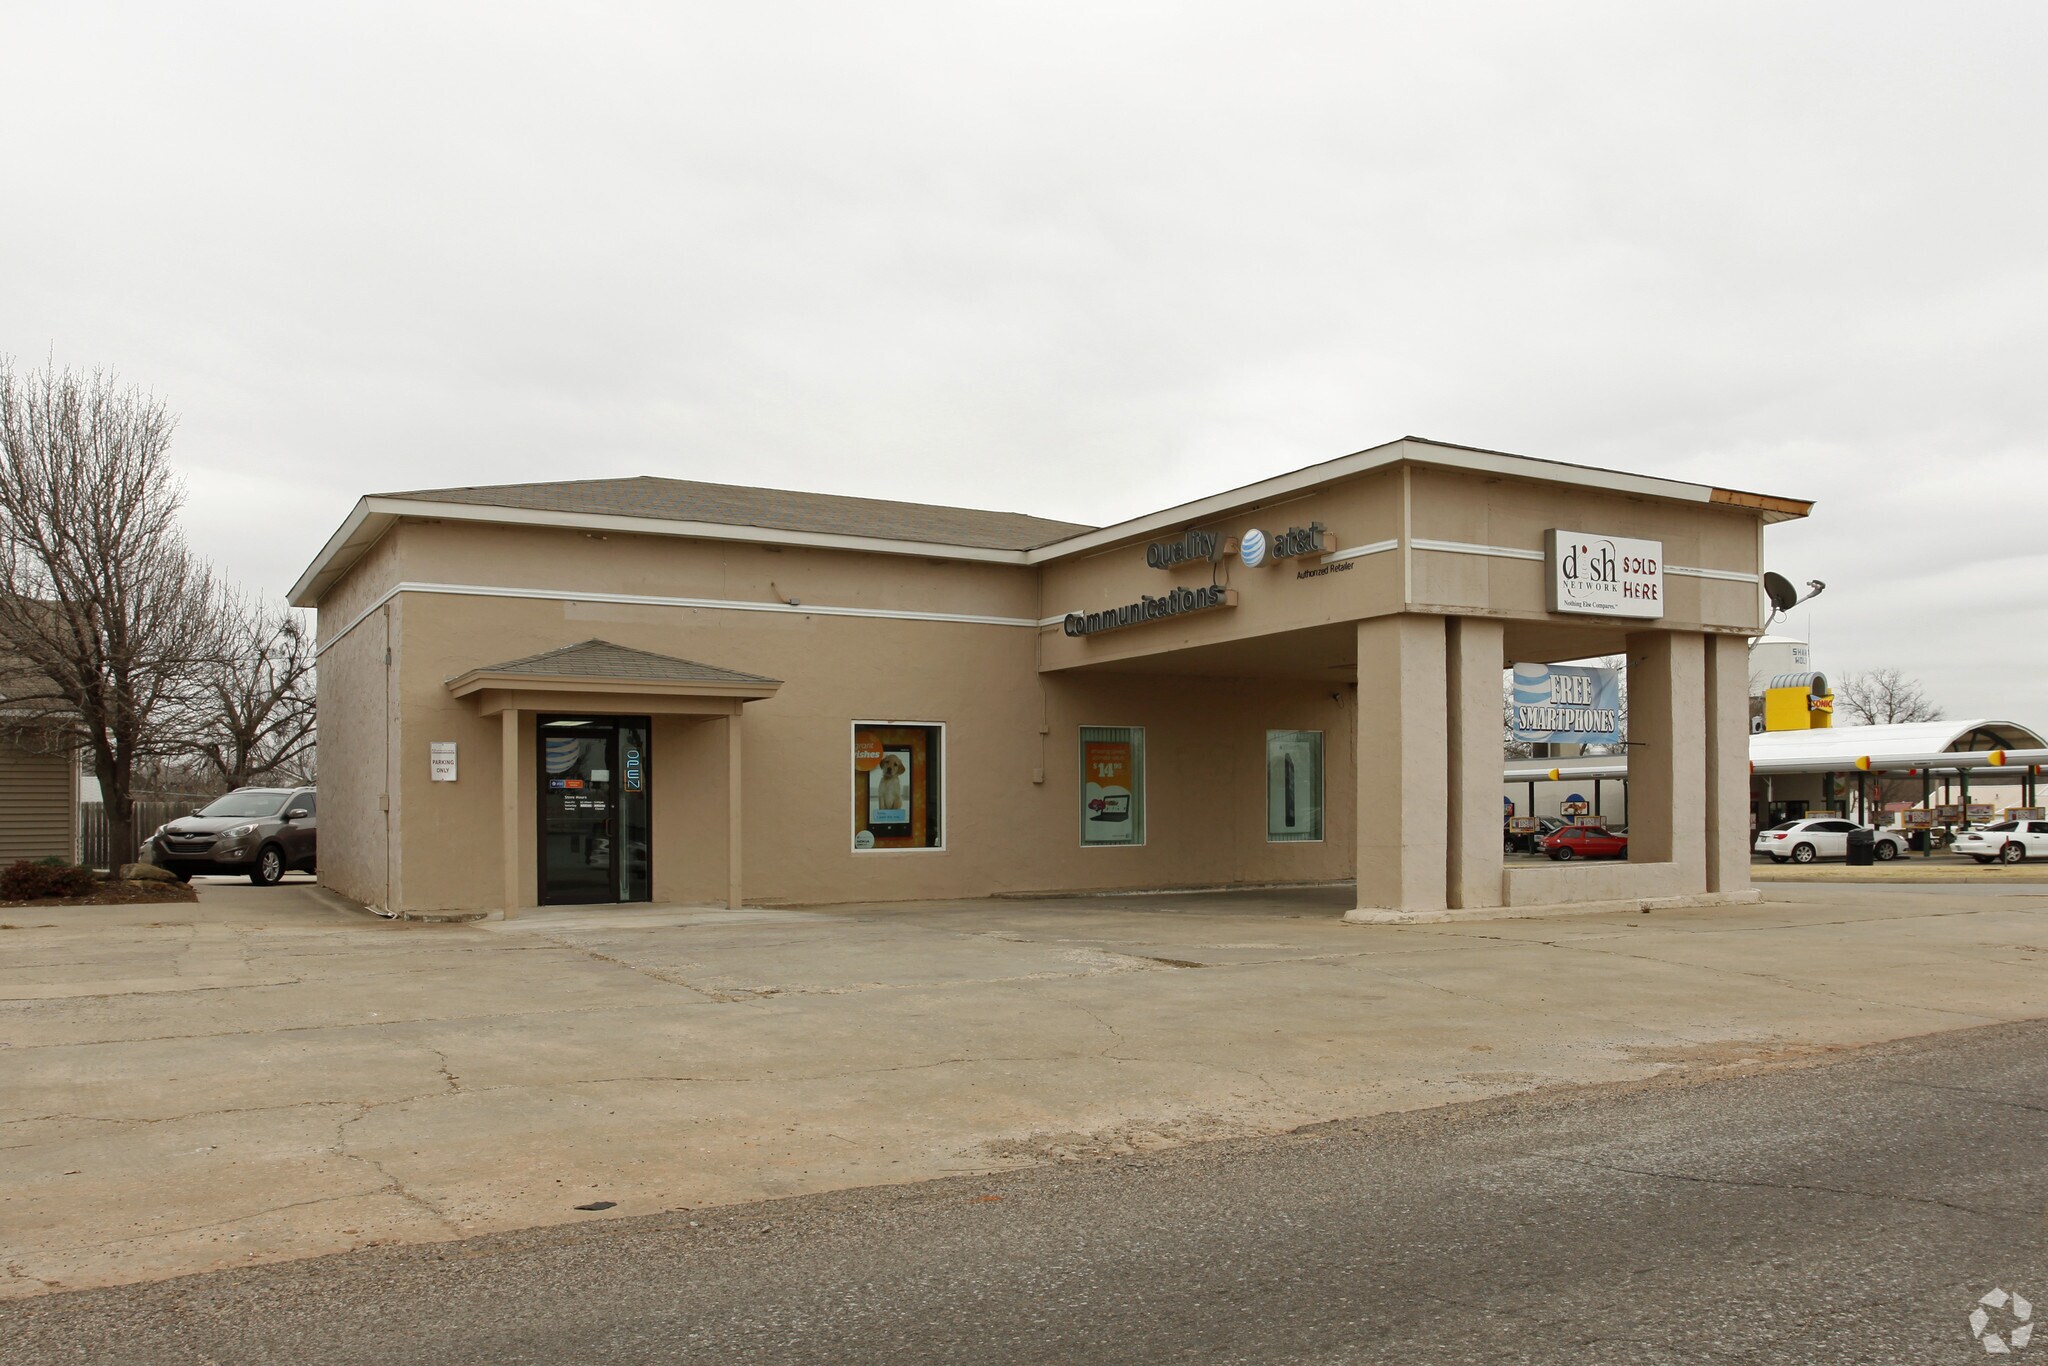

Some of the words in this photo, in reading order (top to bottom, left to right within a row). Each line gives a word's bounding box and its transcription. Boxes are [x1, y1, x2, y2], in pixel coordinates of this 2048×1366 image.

[1146, 531, 1221, 569] Quality
[1271, 520, 1325, 560] at&t
[1296, 566, 1329, 581] Authorized
[1330, 561, 1355, 576] Retailer
[1562, 545, 1618, 582] dish
[1623, 556, 1657, 576] SOLD
[1562, 580, 1618, 593] NETWORK
[1623, 580, 1658, 601] HERE
[1064, 584, 1224, 637] Communications
[1563, 599, 1582, 608] Nothing
[1549, 674, 1591, 705] FREE
[1519, 706, 1614, 732] SMARTPHONES
[626, 749, 641, 789] OPEN
